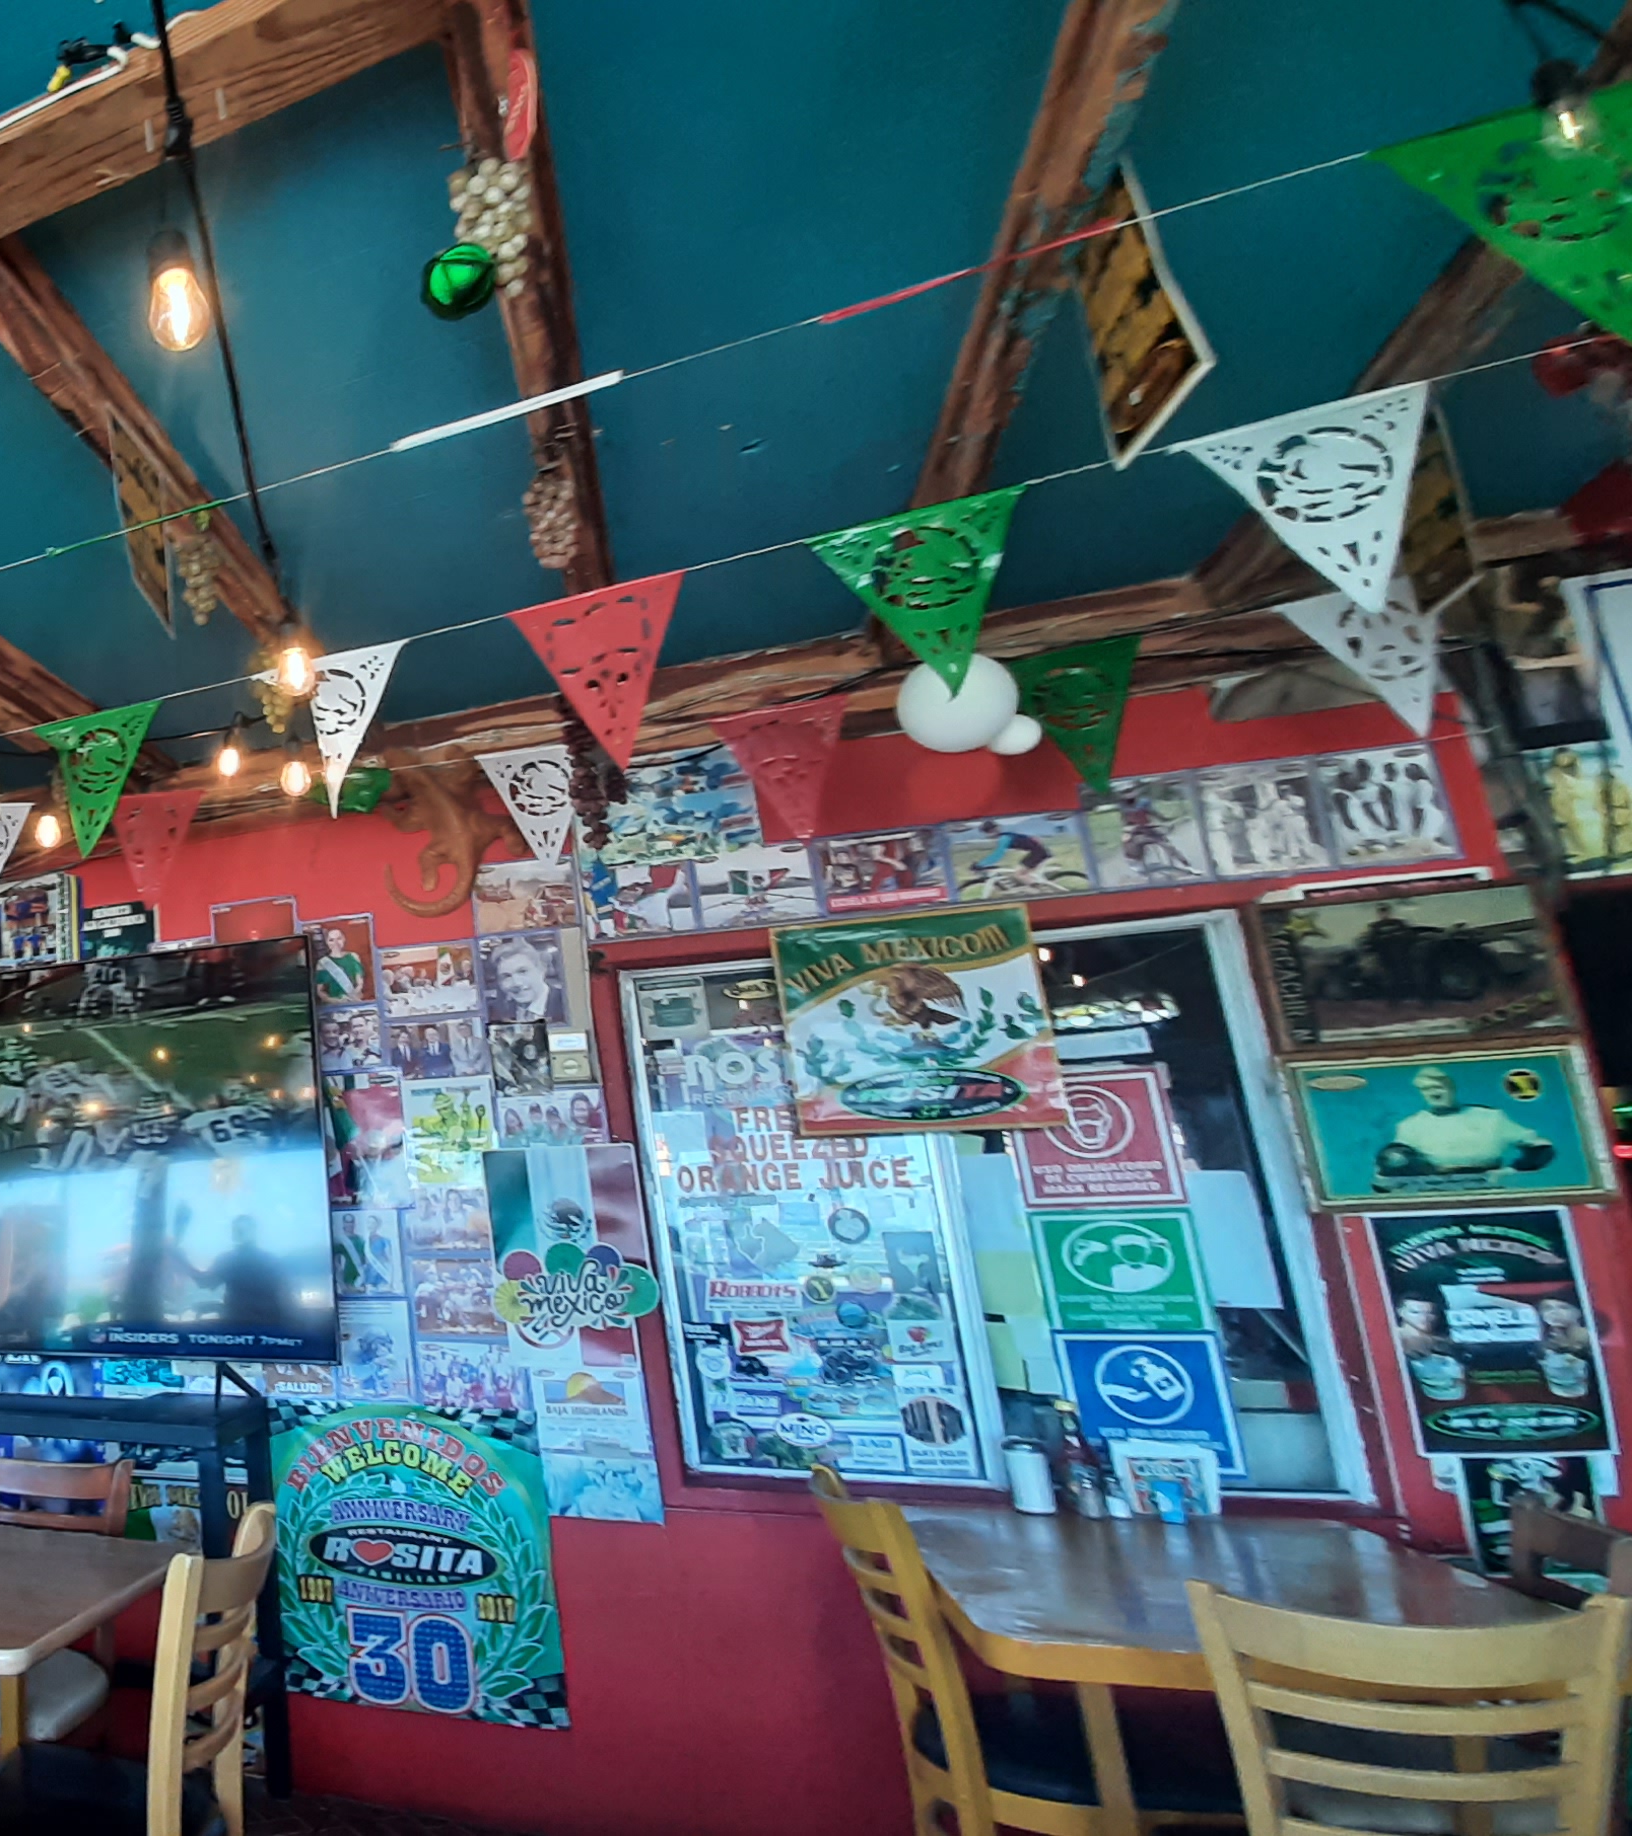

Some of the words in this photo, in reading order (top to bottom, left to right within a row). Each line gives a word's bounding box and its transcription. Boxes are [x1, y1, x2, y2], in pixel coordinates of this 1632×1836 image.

[785, 951, 855, 994] VIVA
[735, 1106, 793, 1132] FRE
[677, 1162, 802, 1194] ORANGE
[819, 1156, 913, 1190] JUICE
[108, 1333, 179, 1344] INSIDERS
[188, 1334, 255, 1345] TONIGHT
[285, 1418, 507, 1498] BIENVENIDOS
[319, 1439, 476, 1498] WELCOME
[345, 1603, 476, 1715] 30
